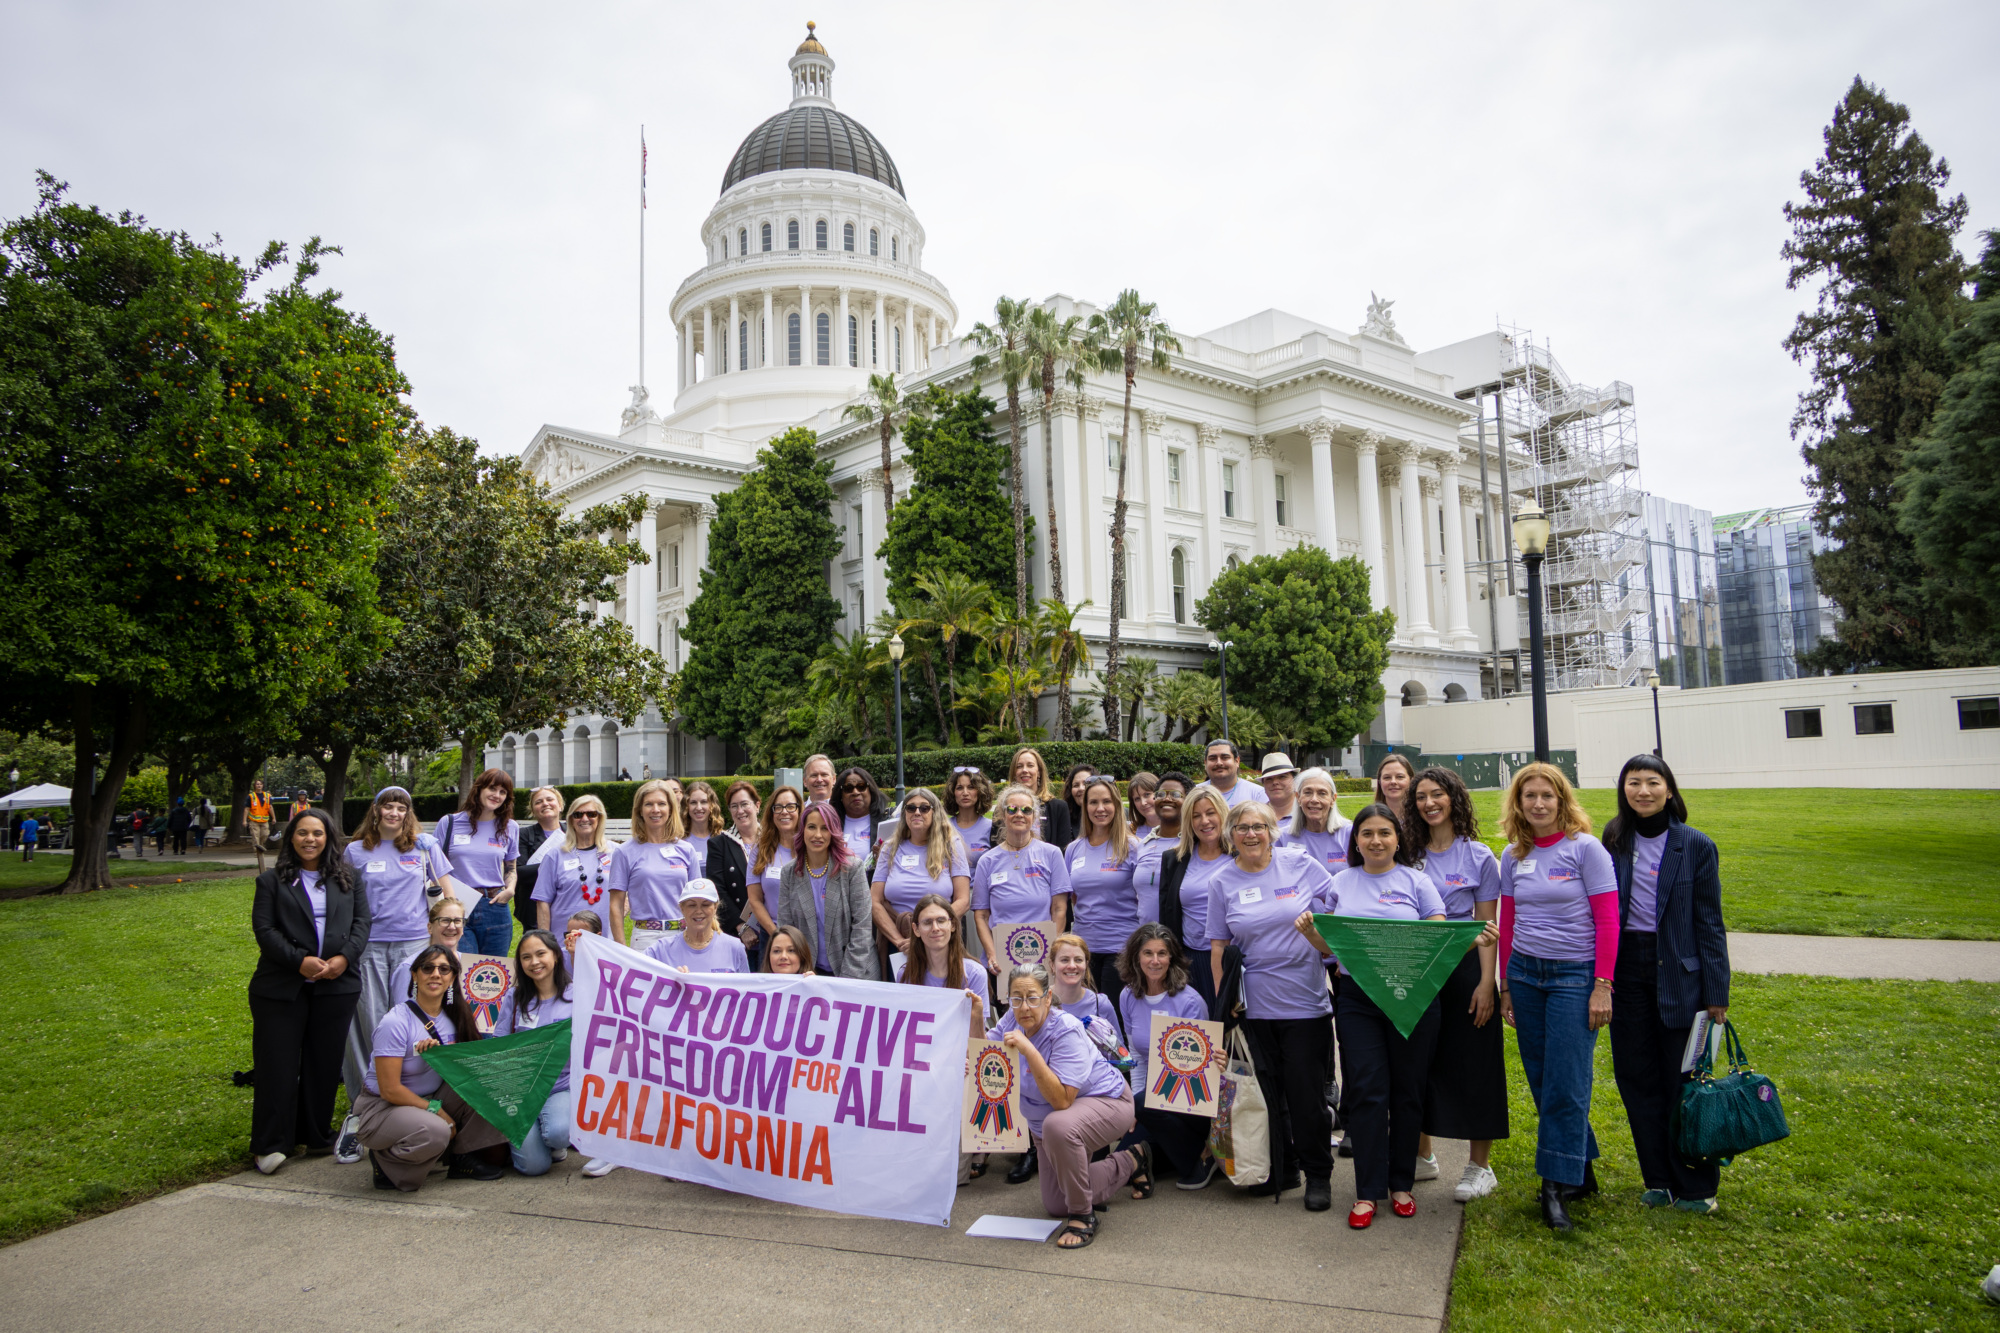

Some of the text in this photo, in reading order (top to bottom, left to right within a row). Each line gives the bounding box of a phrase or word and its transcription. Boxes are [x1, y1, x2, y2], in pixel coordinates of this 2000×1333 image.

[1011, 932, 1031, 950] REPRODUCTIVE
[1015, 947, 1039, 958] Leader
[472, 983, 501, 994] Champion
[597, 958, 935, 1071] REPRODUCTIVE
[1167, 1031, 1205, 1056] REPRODUCTIVE FREEDOM
[981, 1055, 998, 1078] REPRODUCTIVE
[1169, 1050, 1203, 1064] Champion
[583, 1015, 792, 1115] FREEDOM
[792, 1058, 841, 1095] FOR
[834, 1066, 926, 1134] ALL
[982, 1077, 1006, 1090] Champion
[577, 1074, 833, 1186] CALIFORNIA
